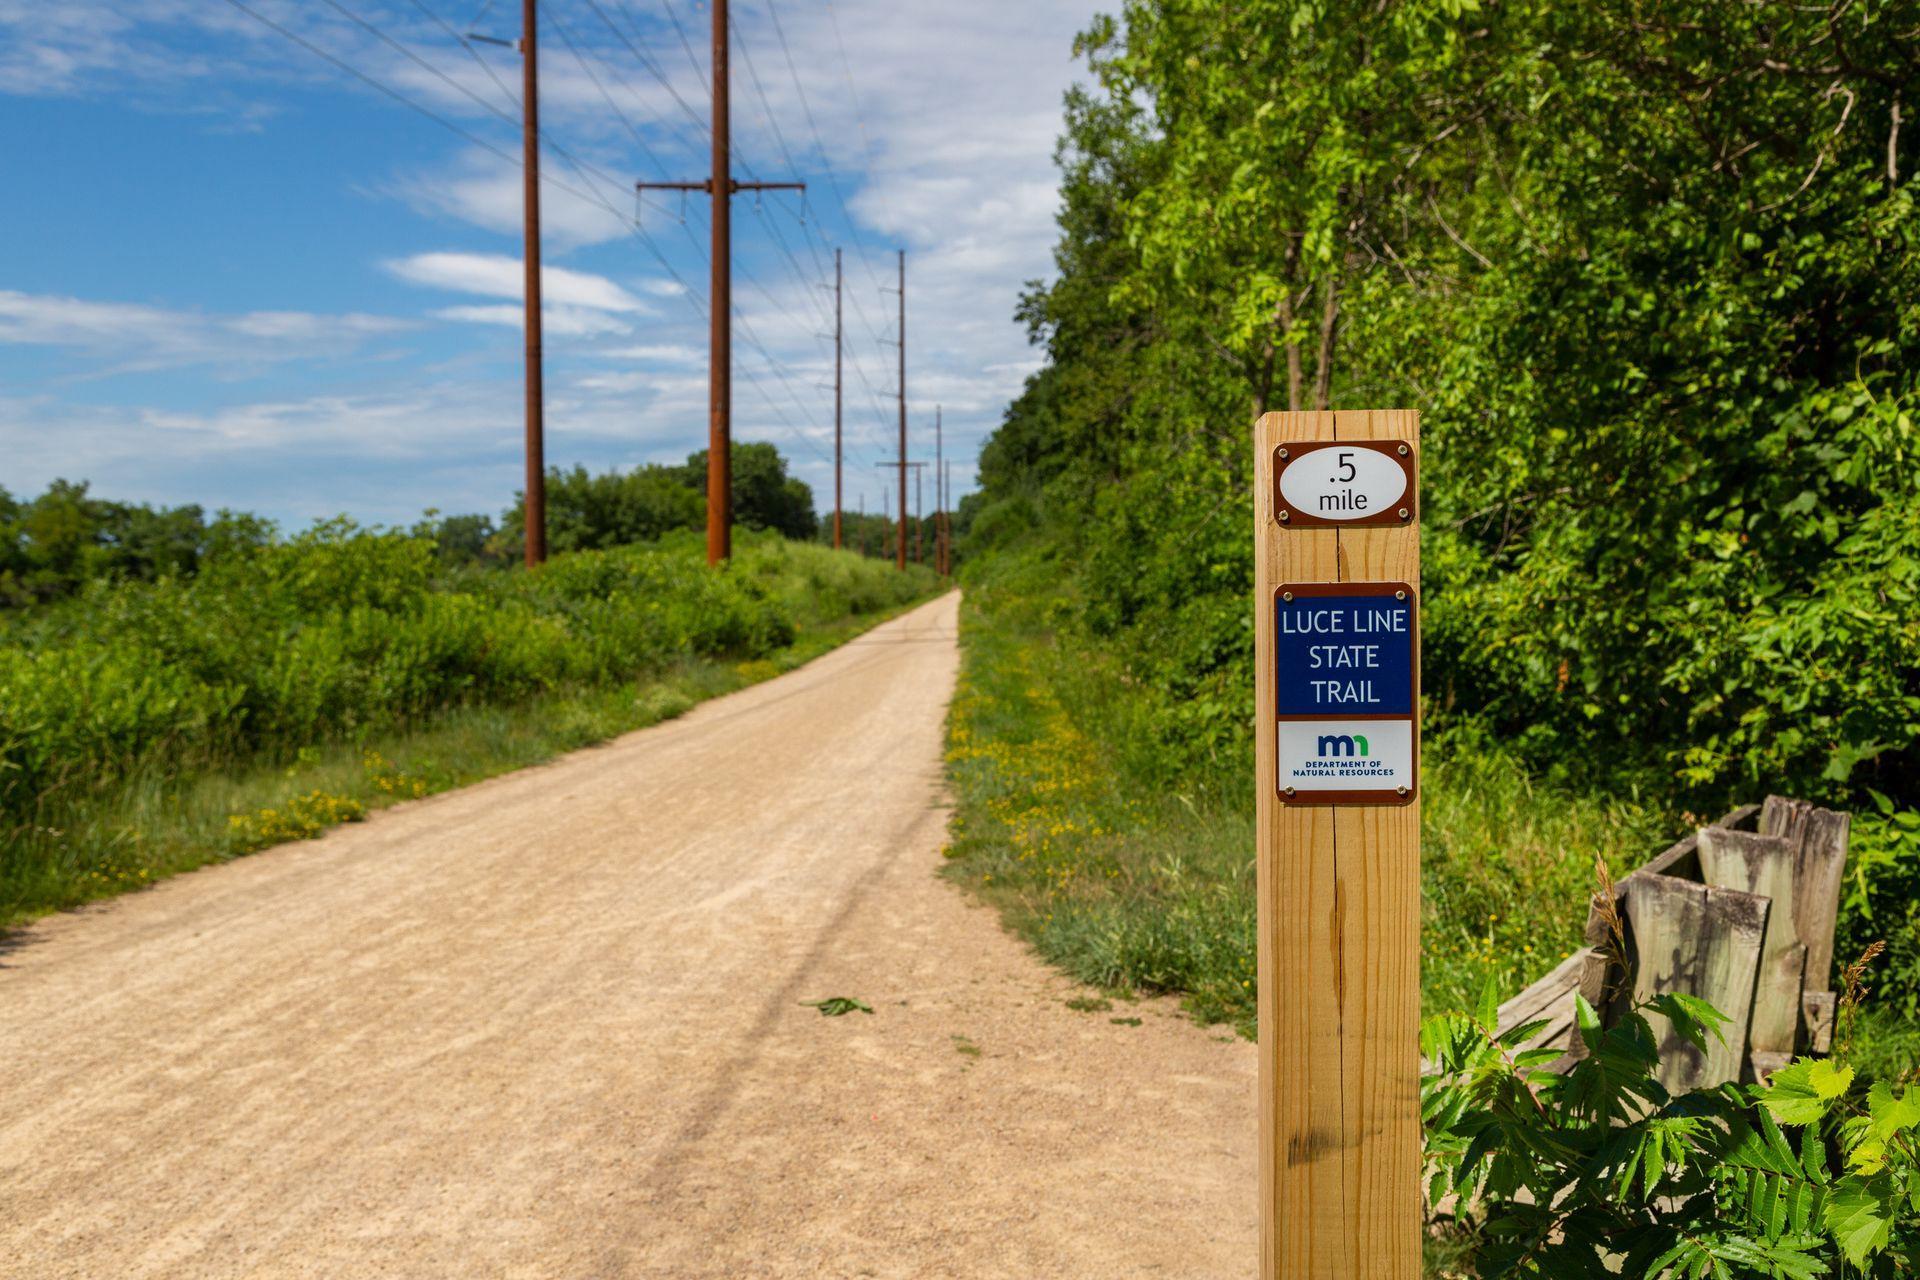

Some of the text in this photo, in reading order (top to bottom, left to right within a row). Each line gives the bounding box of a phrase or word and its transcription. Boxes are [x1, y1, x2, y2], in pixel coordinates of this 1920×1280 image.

[1329, 453, 1356, 482] .5
[1319, 489, 1367, 510] mile
[1283, 609, 1406, 633] LUCE LINE
[1310, 645, 1379, 668] STATE
[1310, 680, 1380, 703] TRAIL
[1369, 760, 1382, 768] OF
